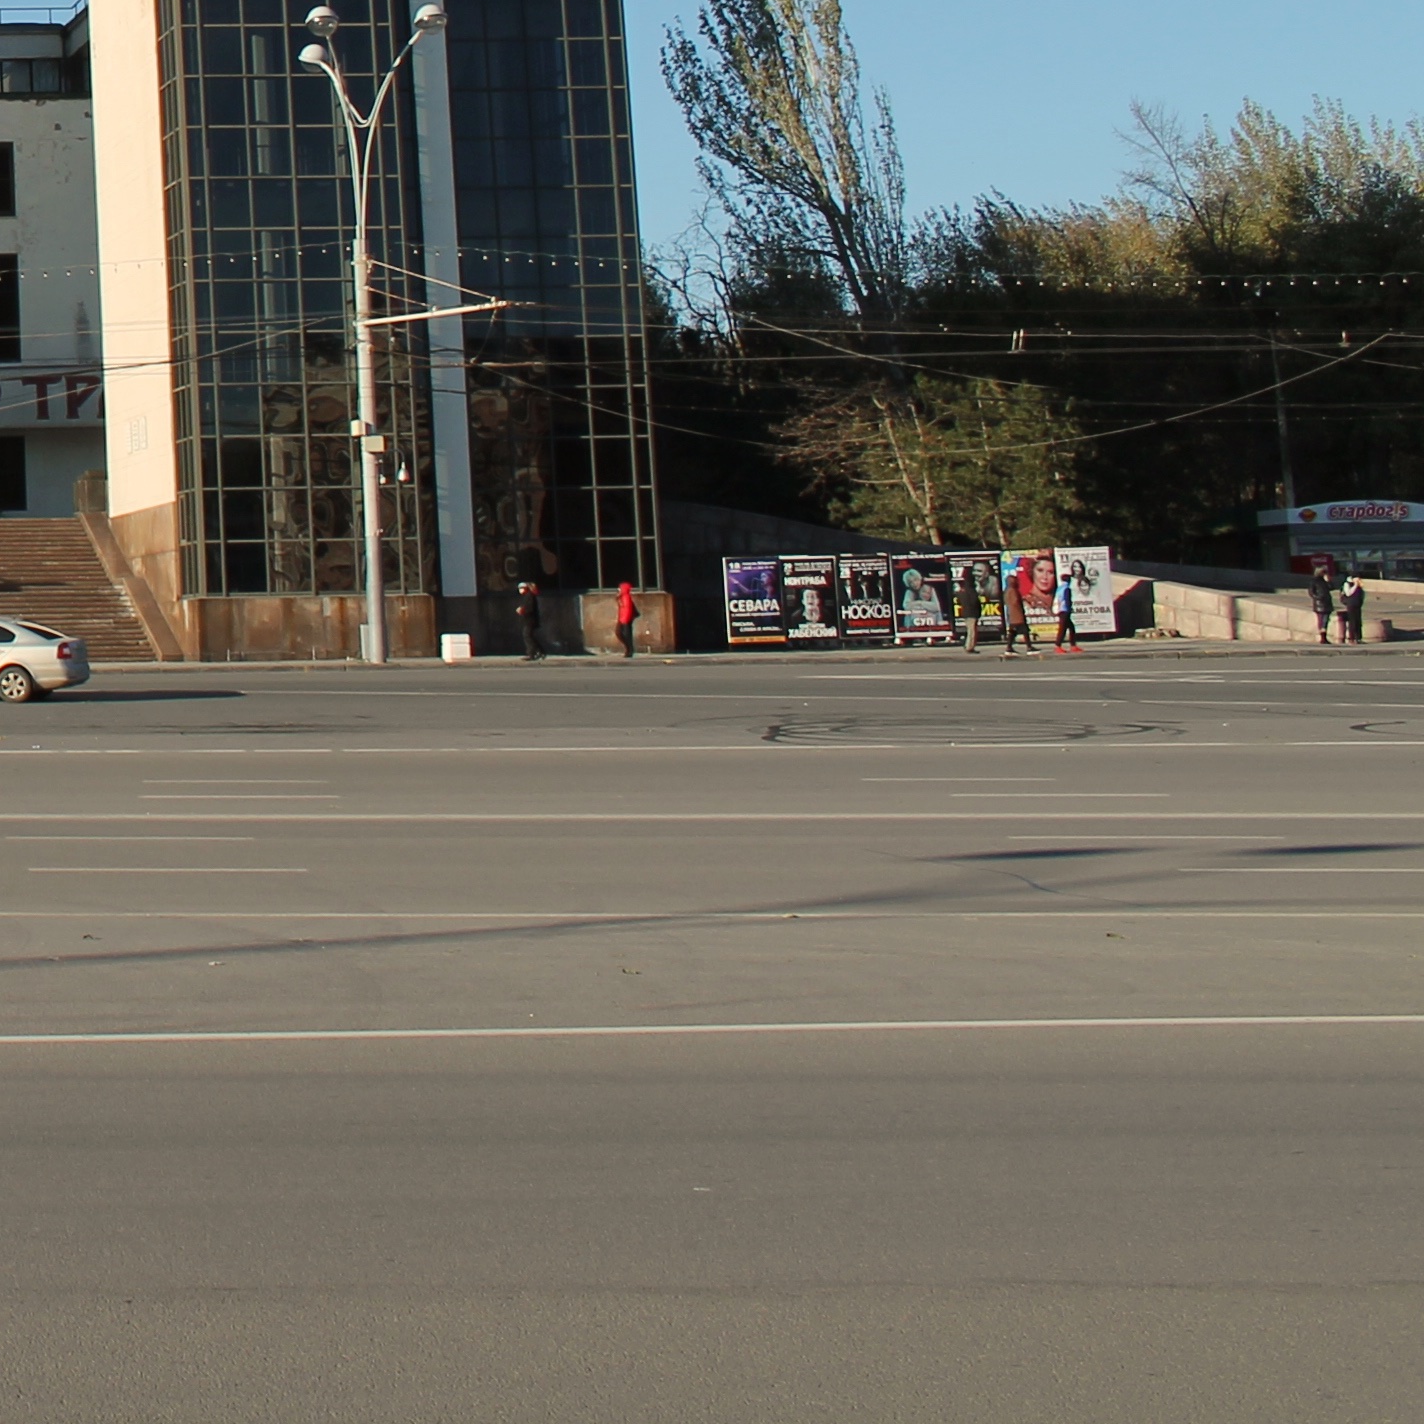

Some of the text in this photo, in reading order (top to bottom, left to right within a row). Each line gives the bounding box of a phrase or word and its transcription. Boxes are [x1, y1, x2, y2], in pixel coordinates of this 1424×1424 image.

[21, 375, 105, 421] ТР
[729, 598, 780, 612] СЕВАРА
[841, 604, 892, 619] НОСКОВ
[1070, 606, 1111, 614] АМАТОВА
